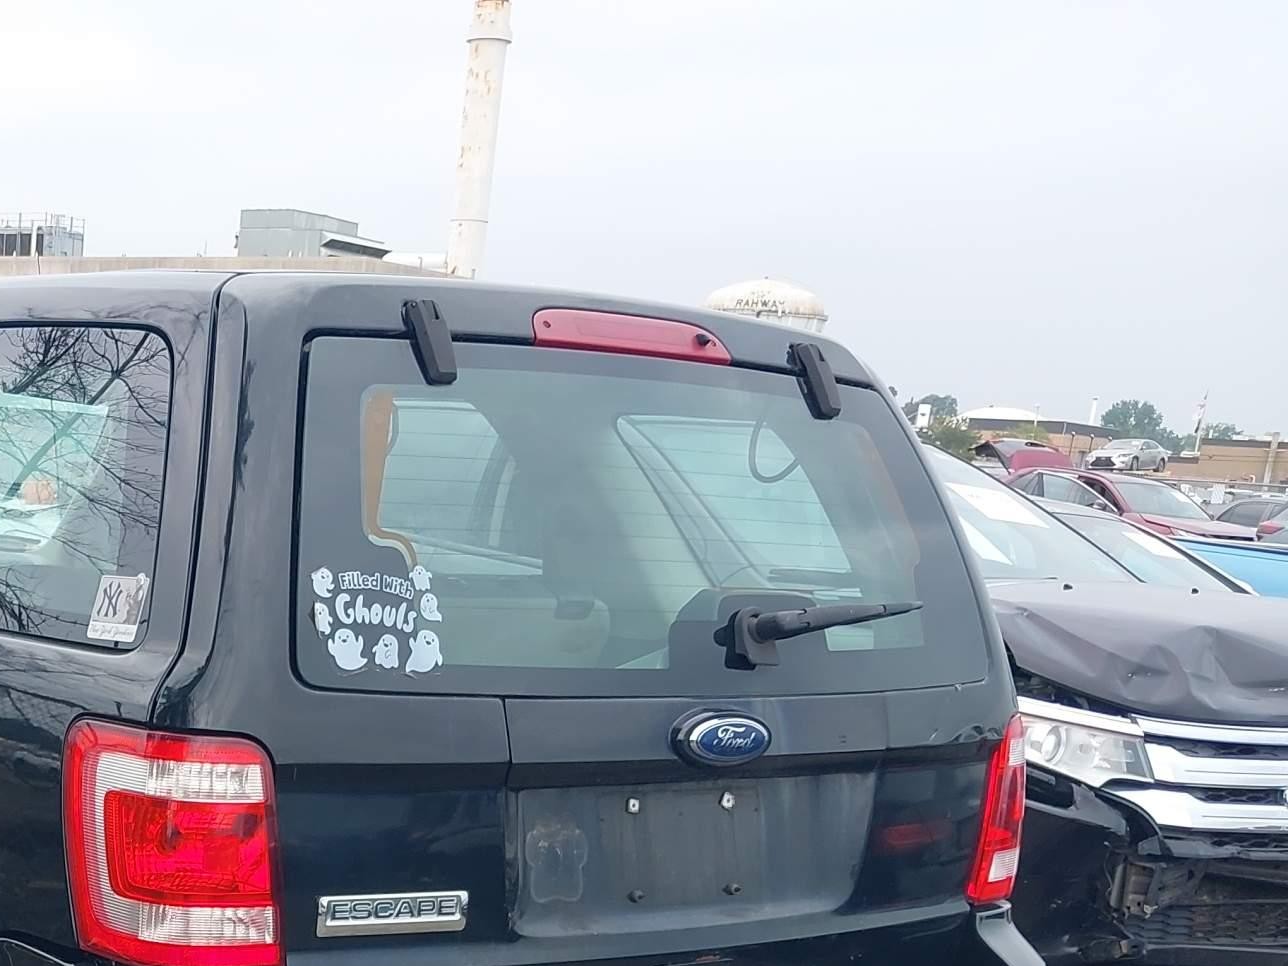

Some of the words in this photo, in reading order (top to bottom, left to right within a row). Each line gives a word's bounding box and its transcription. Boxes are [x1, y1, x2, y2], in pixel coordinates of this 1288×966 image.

[735, 298, 785, 309] RAHWAY
[97, 580, 123, 618] NY
[339, 572, 380, 589] Filled
[383, 575, 414, 600] With
[335, 592, 417, 633] Ghouls
[713, 725, 756, 749] Ford
[329, 897, 458, 921] ESCAPE
